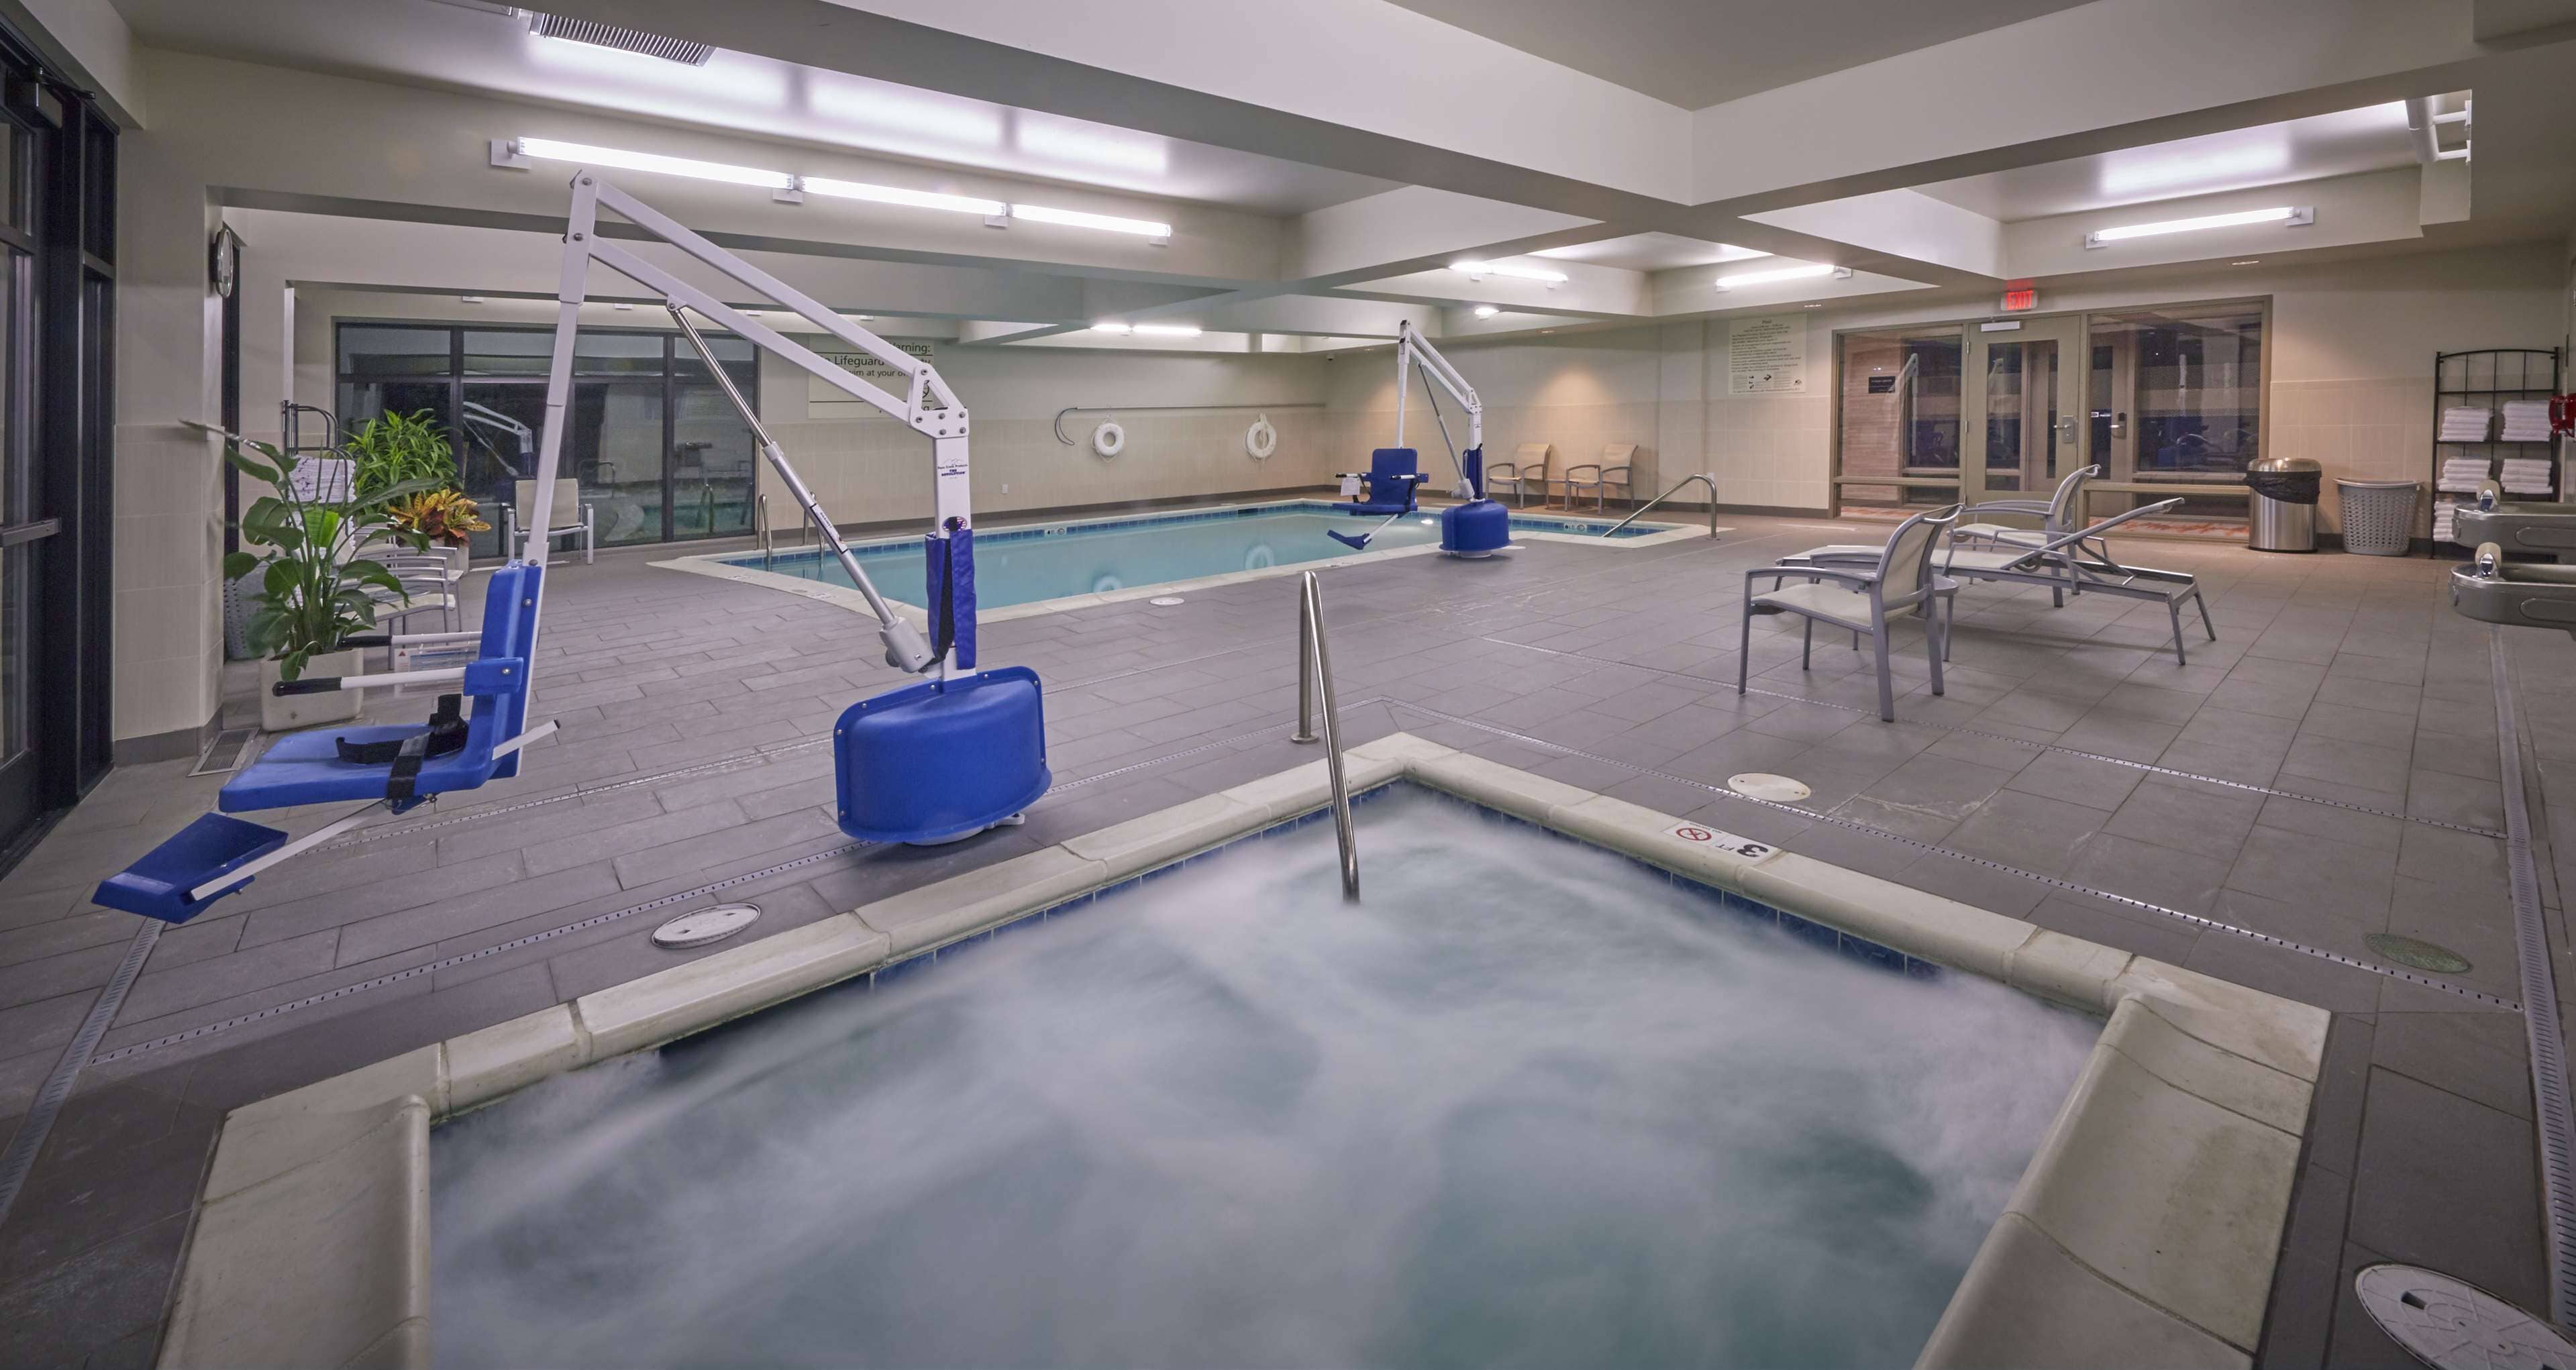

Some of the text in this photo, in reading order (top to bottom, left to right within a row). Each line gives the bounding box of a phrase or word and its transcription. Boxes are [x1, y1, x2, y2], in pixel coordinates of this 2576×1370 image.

[2006, 290, 2034, 311] EXIT
[890, 342, 931, 354] arning:
[1737, 844, 1769, 857] 3
